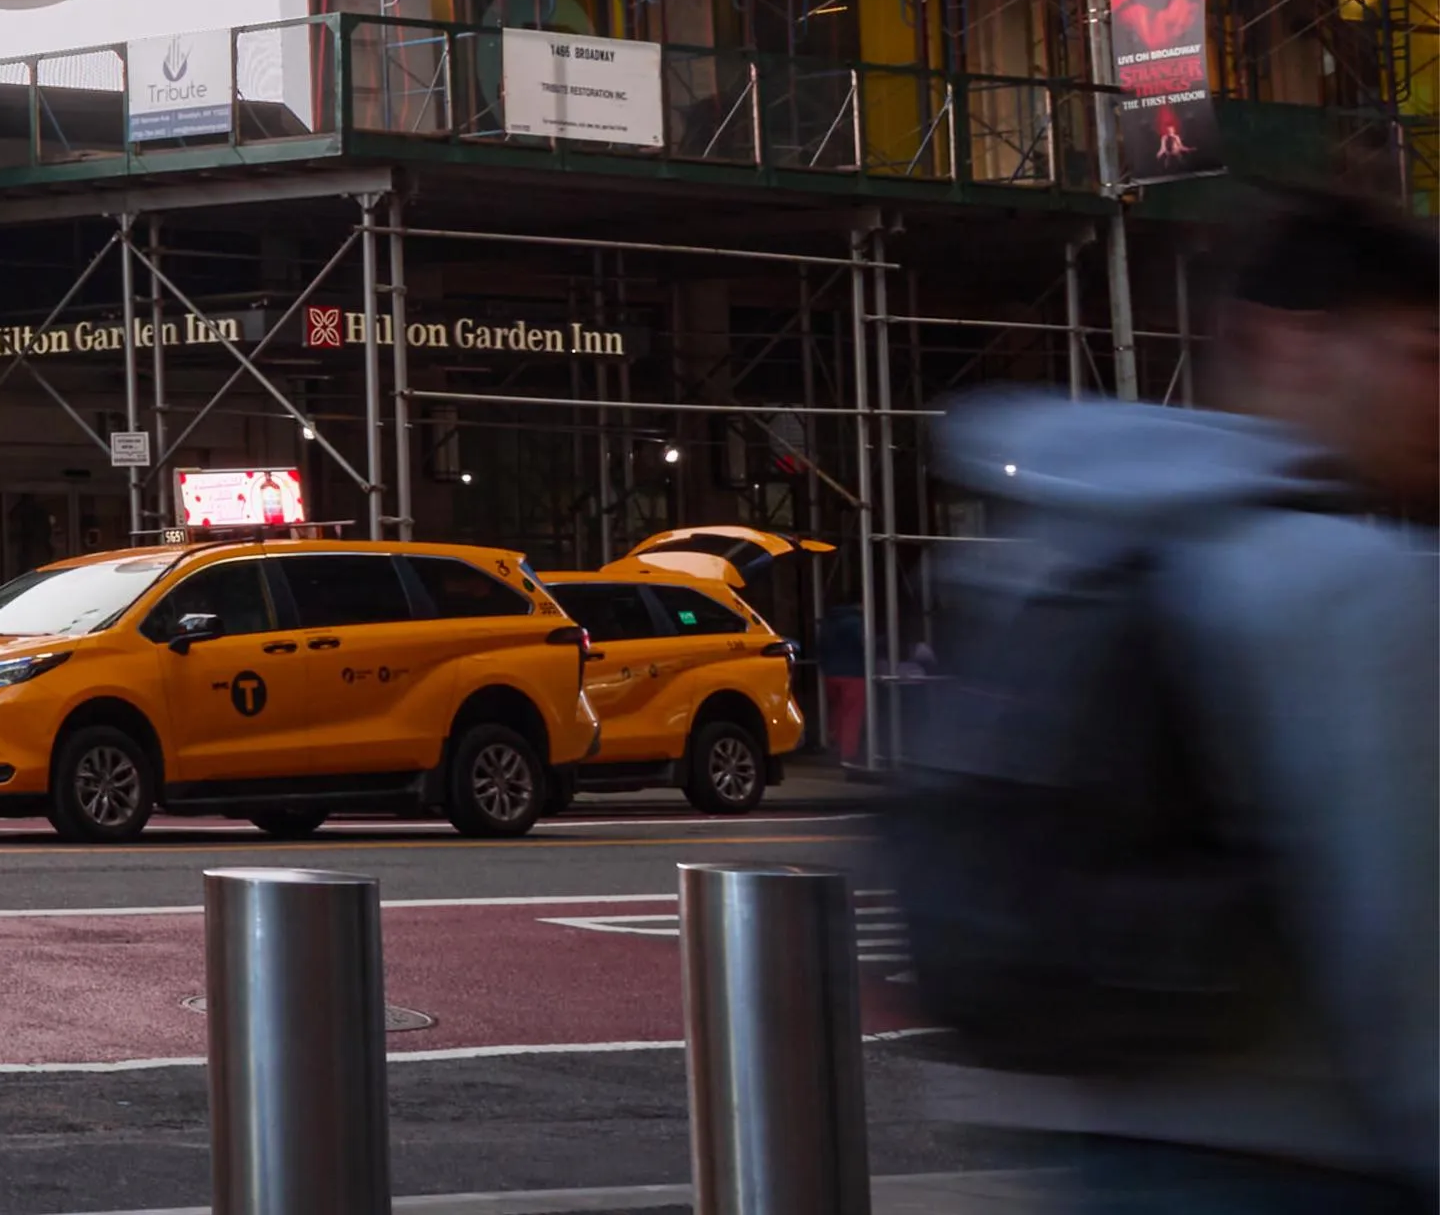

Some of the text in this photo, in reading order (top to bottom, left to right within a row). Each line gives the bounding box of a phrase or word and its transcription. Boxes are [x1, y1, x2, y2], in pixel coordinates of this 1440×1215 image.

[575, 47, 615, 62] BROADWAY
[1135, 52, 1149, 62] ON
[147, 80, 208, 103] Tribute
[185, 313, 239, 344] Inn
[344, 312, 624, 356] Hilon Garden Inn
